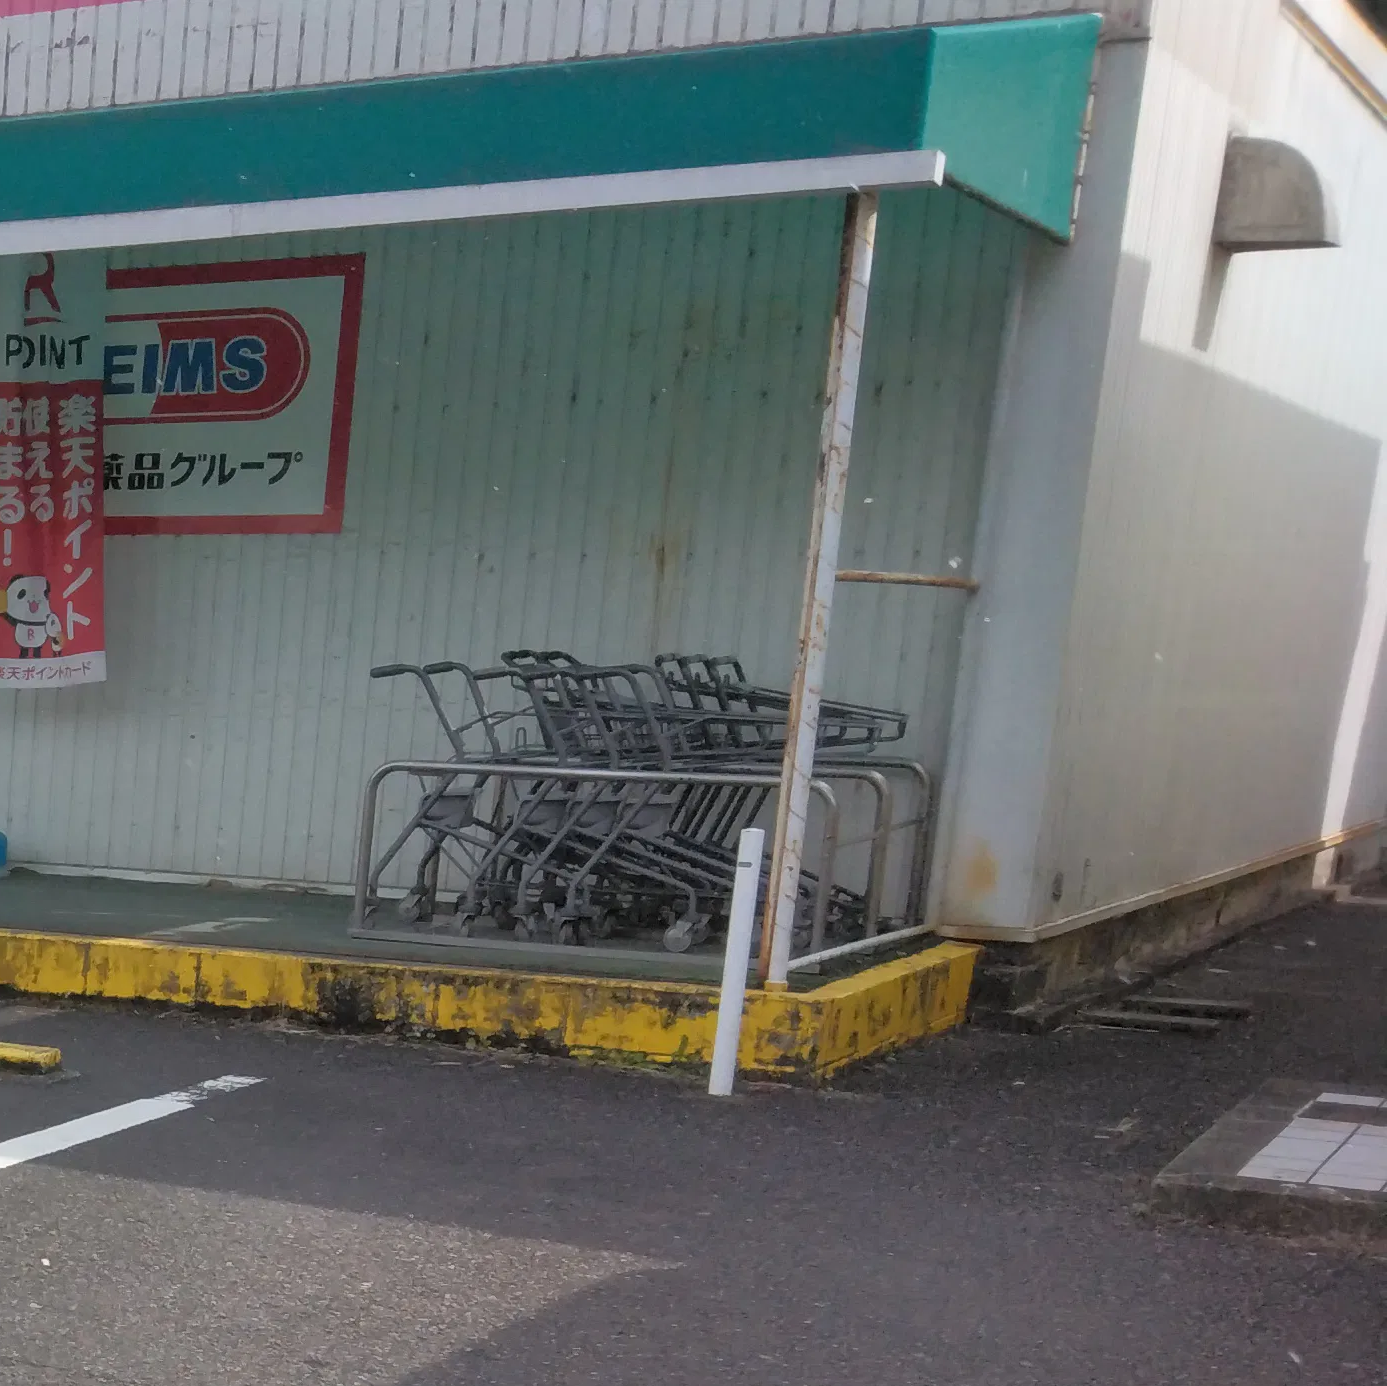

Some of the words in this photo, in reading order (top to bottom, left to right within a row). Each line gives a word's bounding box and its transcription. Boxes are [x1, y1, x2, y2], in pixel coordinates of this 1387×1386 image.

[24, 396, 55, 522] 使える
[58, 394, 96, 640] 楽天ポイント
